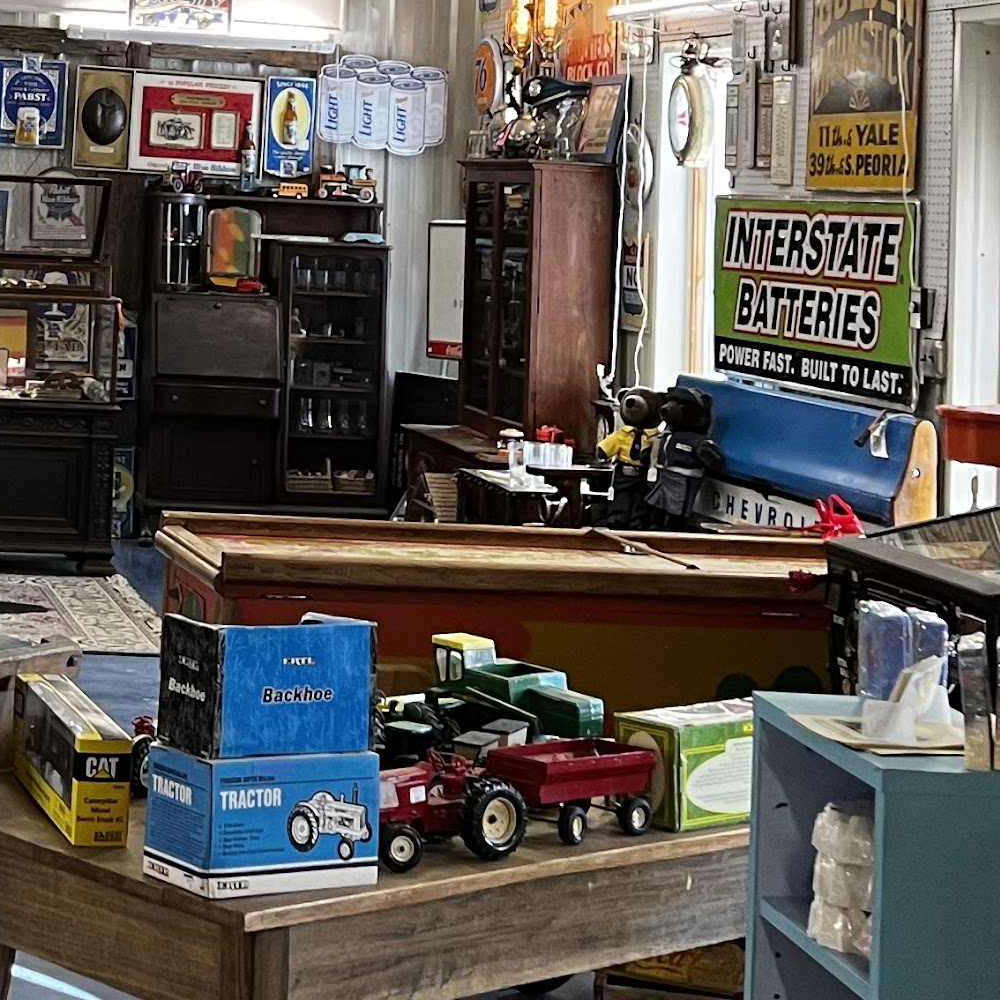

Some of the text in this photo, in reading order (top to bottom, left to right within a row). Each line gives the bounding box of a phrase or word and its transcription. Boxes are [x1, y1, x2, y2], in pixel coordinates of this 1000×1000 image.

[475, 59, 487, 96] 76
[566, 62, 593, 81] BLOCK
[13, 91, 48, 102] PABST
[324, 95, 339, 131] LIGHT
[359, 100, 373, 137] LIGHT
[392, 106, 408, 143] LIGHT
[856, 123, 899, 146] YALE
[855, 153, 910, 177] PEORIA
[724, 213, 902, 279] INTERSTATE
[736, 280, 879, 346] BATTERIES
[719, 343, 903, 395] POWER FAST. BUILT TO LAST.
[712, 490, 808, 530] CHEVROL
[168, 676, 206, 702] Backhoe
[262, 685, 334, 704] Backhoe
[85, 756, 120, 779] CAT
[151, 774, 193, 806] TRACTOR
[219, 787, 282, 812] TRACTOR
